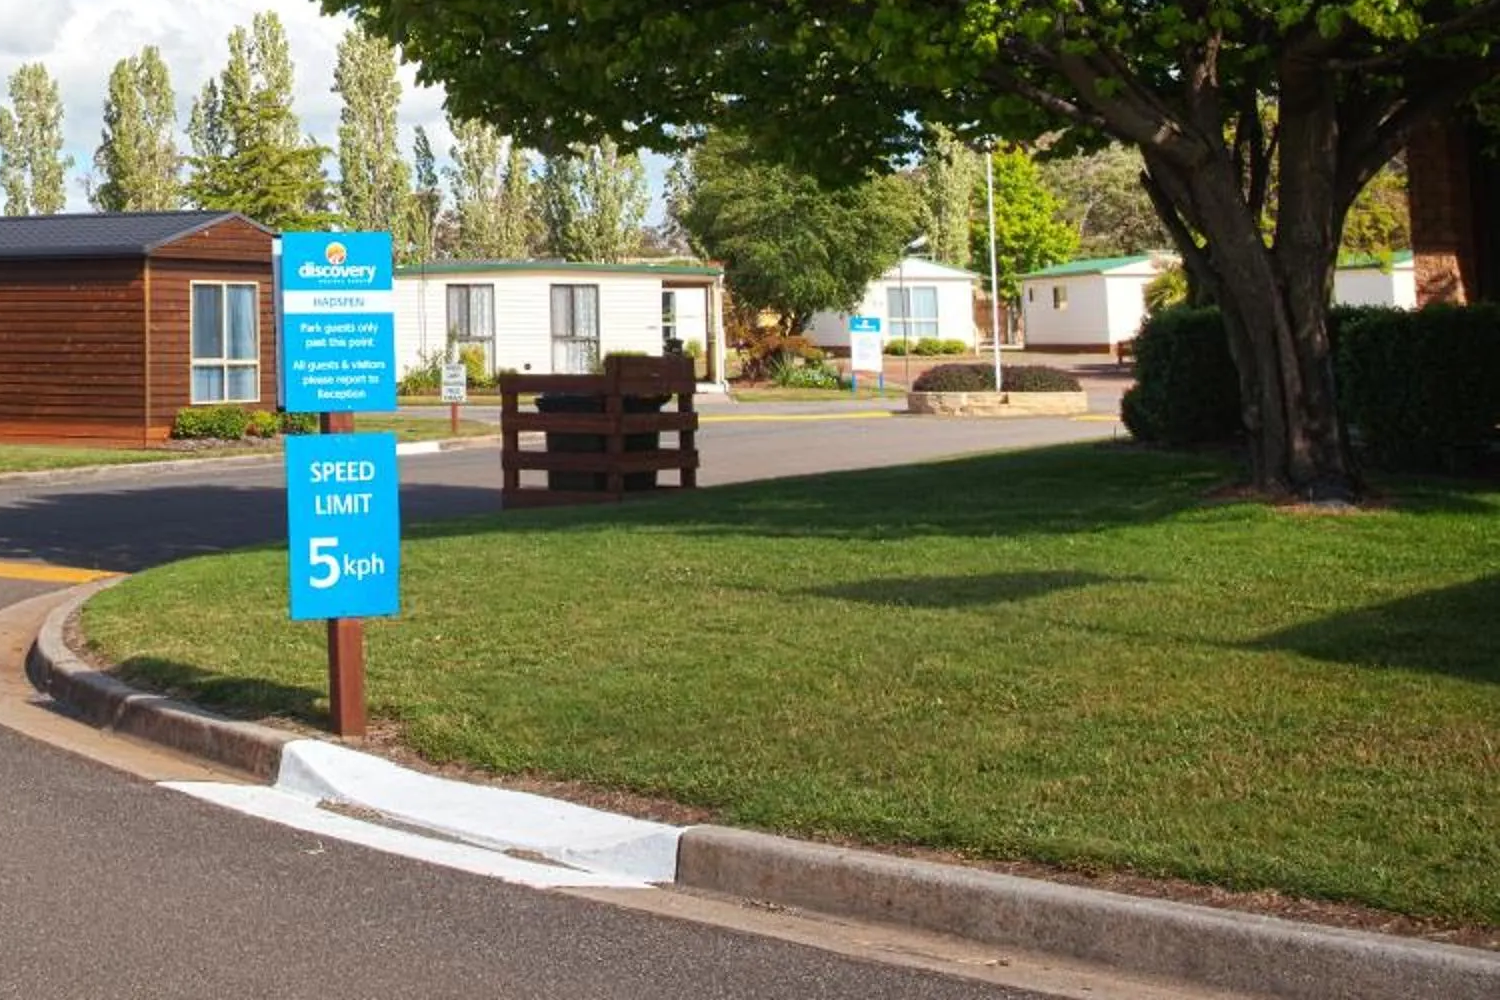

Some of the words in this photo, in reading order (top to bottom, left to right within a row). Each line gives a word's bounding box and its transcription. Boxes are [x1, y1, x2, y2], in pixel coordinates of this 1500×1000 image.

[299, 262, 376, 283] discovery
[300, 323, 321, 333] Park
[324, 324, 355, 335] guests
[358, 322, 379, 335] only
[305, 339, 326, 350] past
[293, 360, 306, 370] All
[308, 361, 339, 372] guests
[341, 360, 350, 369] &
[352, 360, 386, 369] visitors
[302, 376, 334, 387] please
[336, 375, 367, 386] report
[368, 376, 380, 385] to
[317, 388, 366, 400] Reception
[310, 461, 375, 483] SPEED
[315, 493, 372, 515] LIMIT
[309, 537, 340, 589] 5
[343, 552, 385, 580] kph
